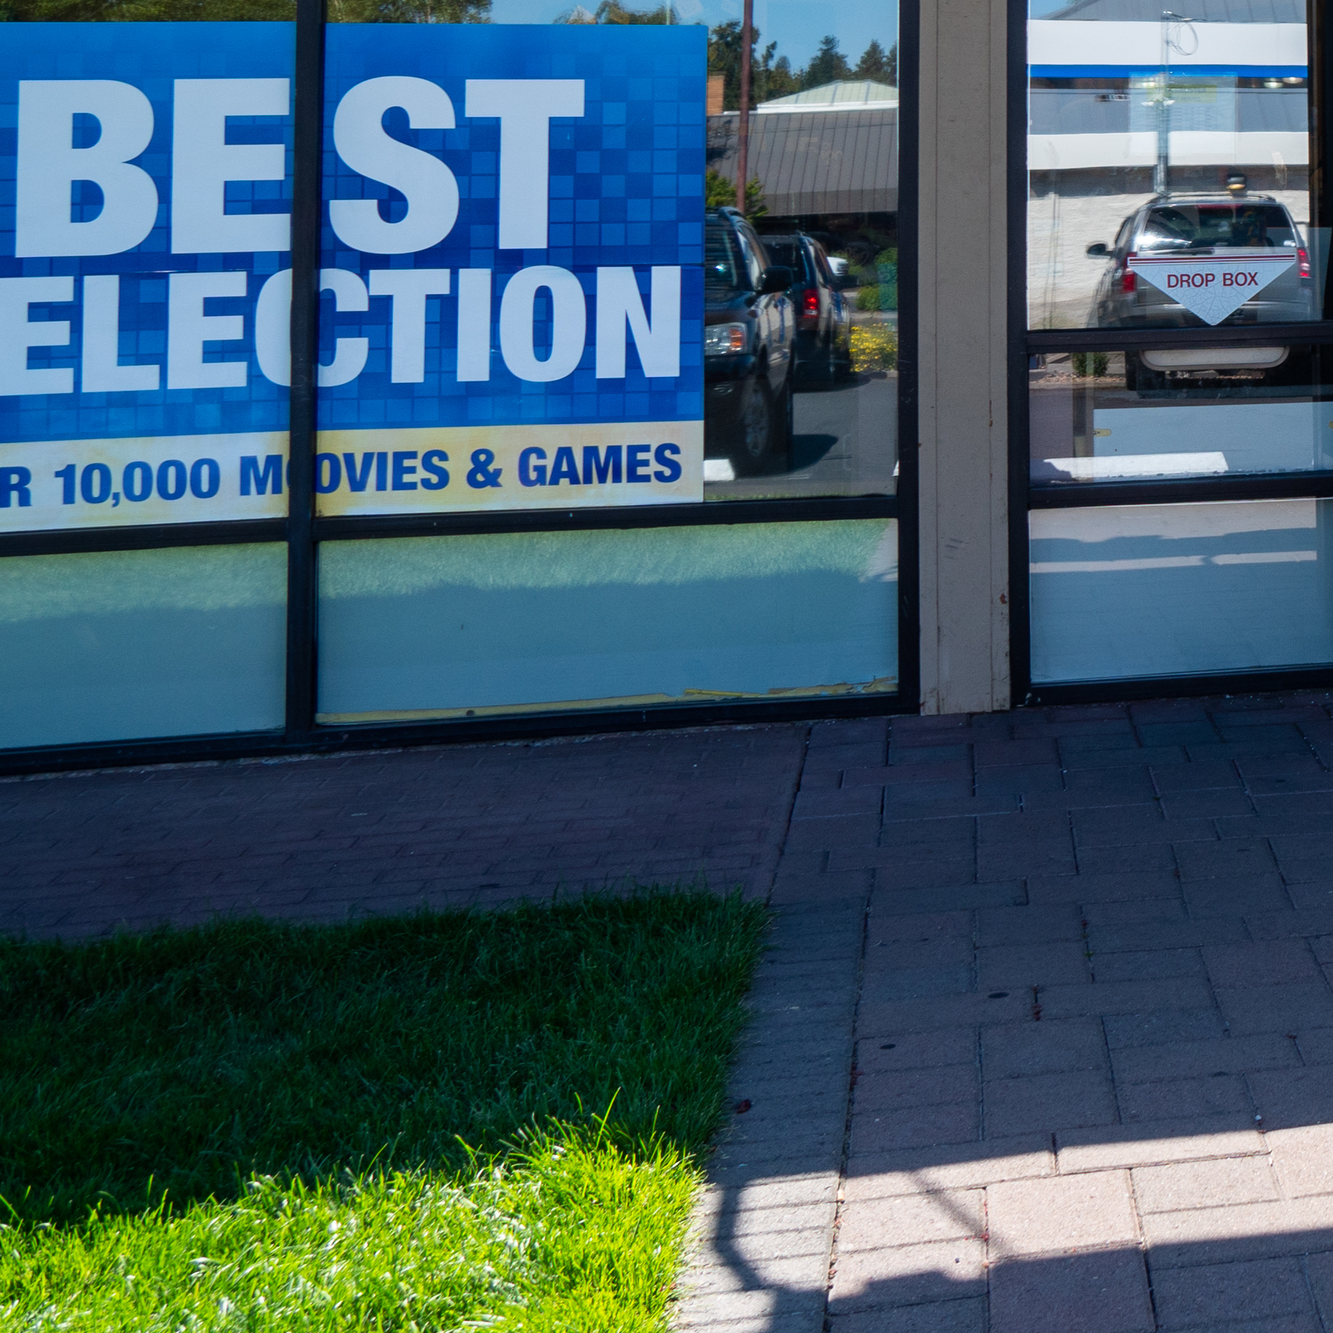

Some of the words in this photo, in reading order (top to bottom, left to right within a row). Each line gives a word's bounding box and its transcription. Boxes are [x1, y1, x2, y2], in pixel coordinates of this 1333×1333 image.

[14, 76, 586, 258] BEST
[1166, 273, 1215, 288] DROP
[1222, 272, 1259, 287] BOX
[54, 457, 220, 508] 10,000
[239, 449, 450, 497] MOVIES
[466, 449, 503, 489] &
[517, 442, 683, 487] GAMES
